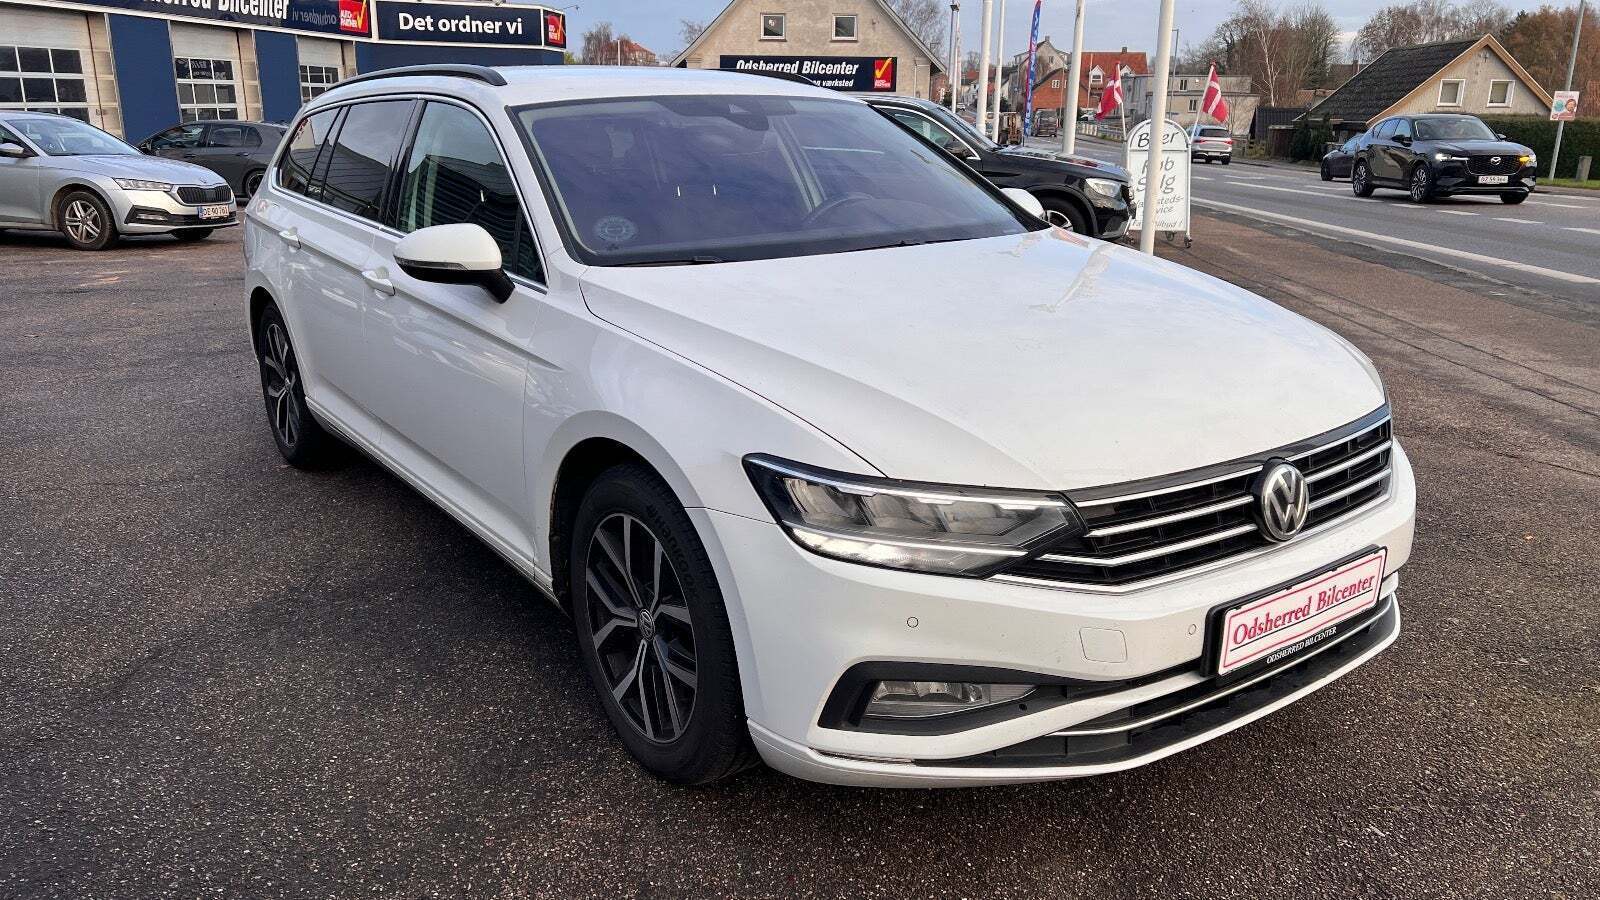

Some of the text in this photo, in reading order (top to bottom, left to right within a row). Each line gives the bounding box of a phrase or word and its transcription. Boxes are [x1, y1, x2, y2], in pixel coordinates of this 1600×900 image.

[398, 12, 523, 35] Det ordner vi
[801, 60, 859, 75] Bilcenter
[822, 79, 854, 87] værksted
[1233, 575, 1376, 645] Odsherred Bilcenter
[1266, 626, 1337, 664] ODSHERRED BILCENTER
